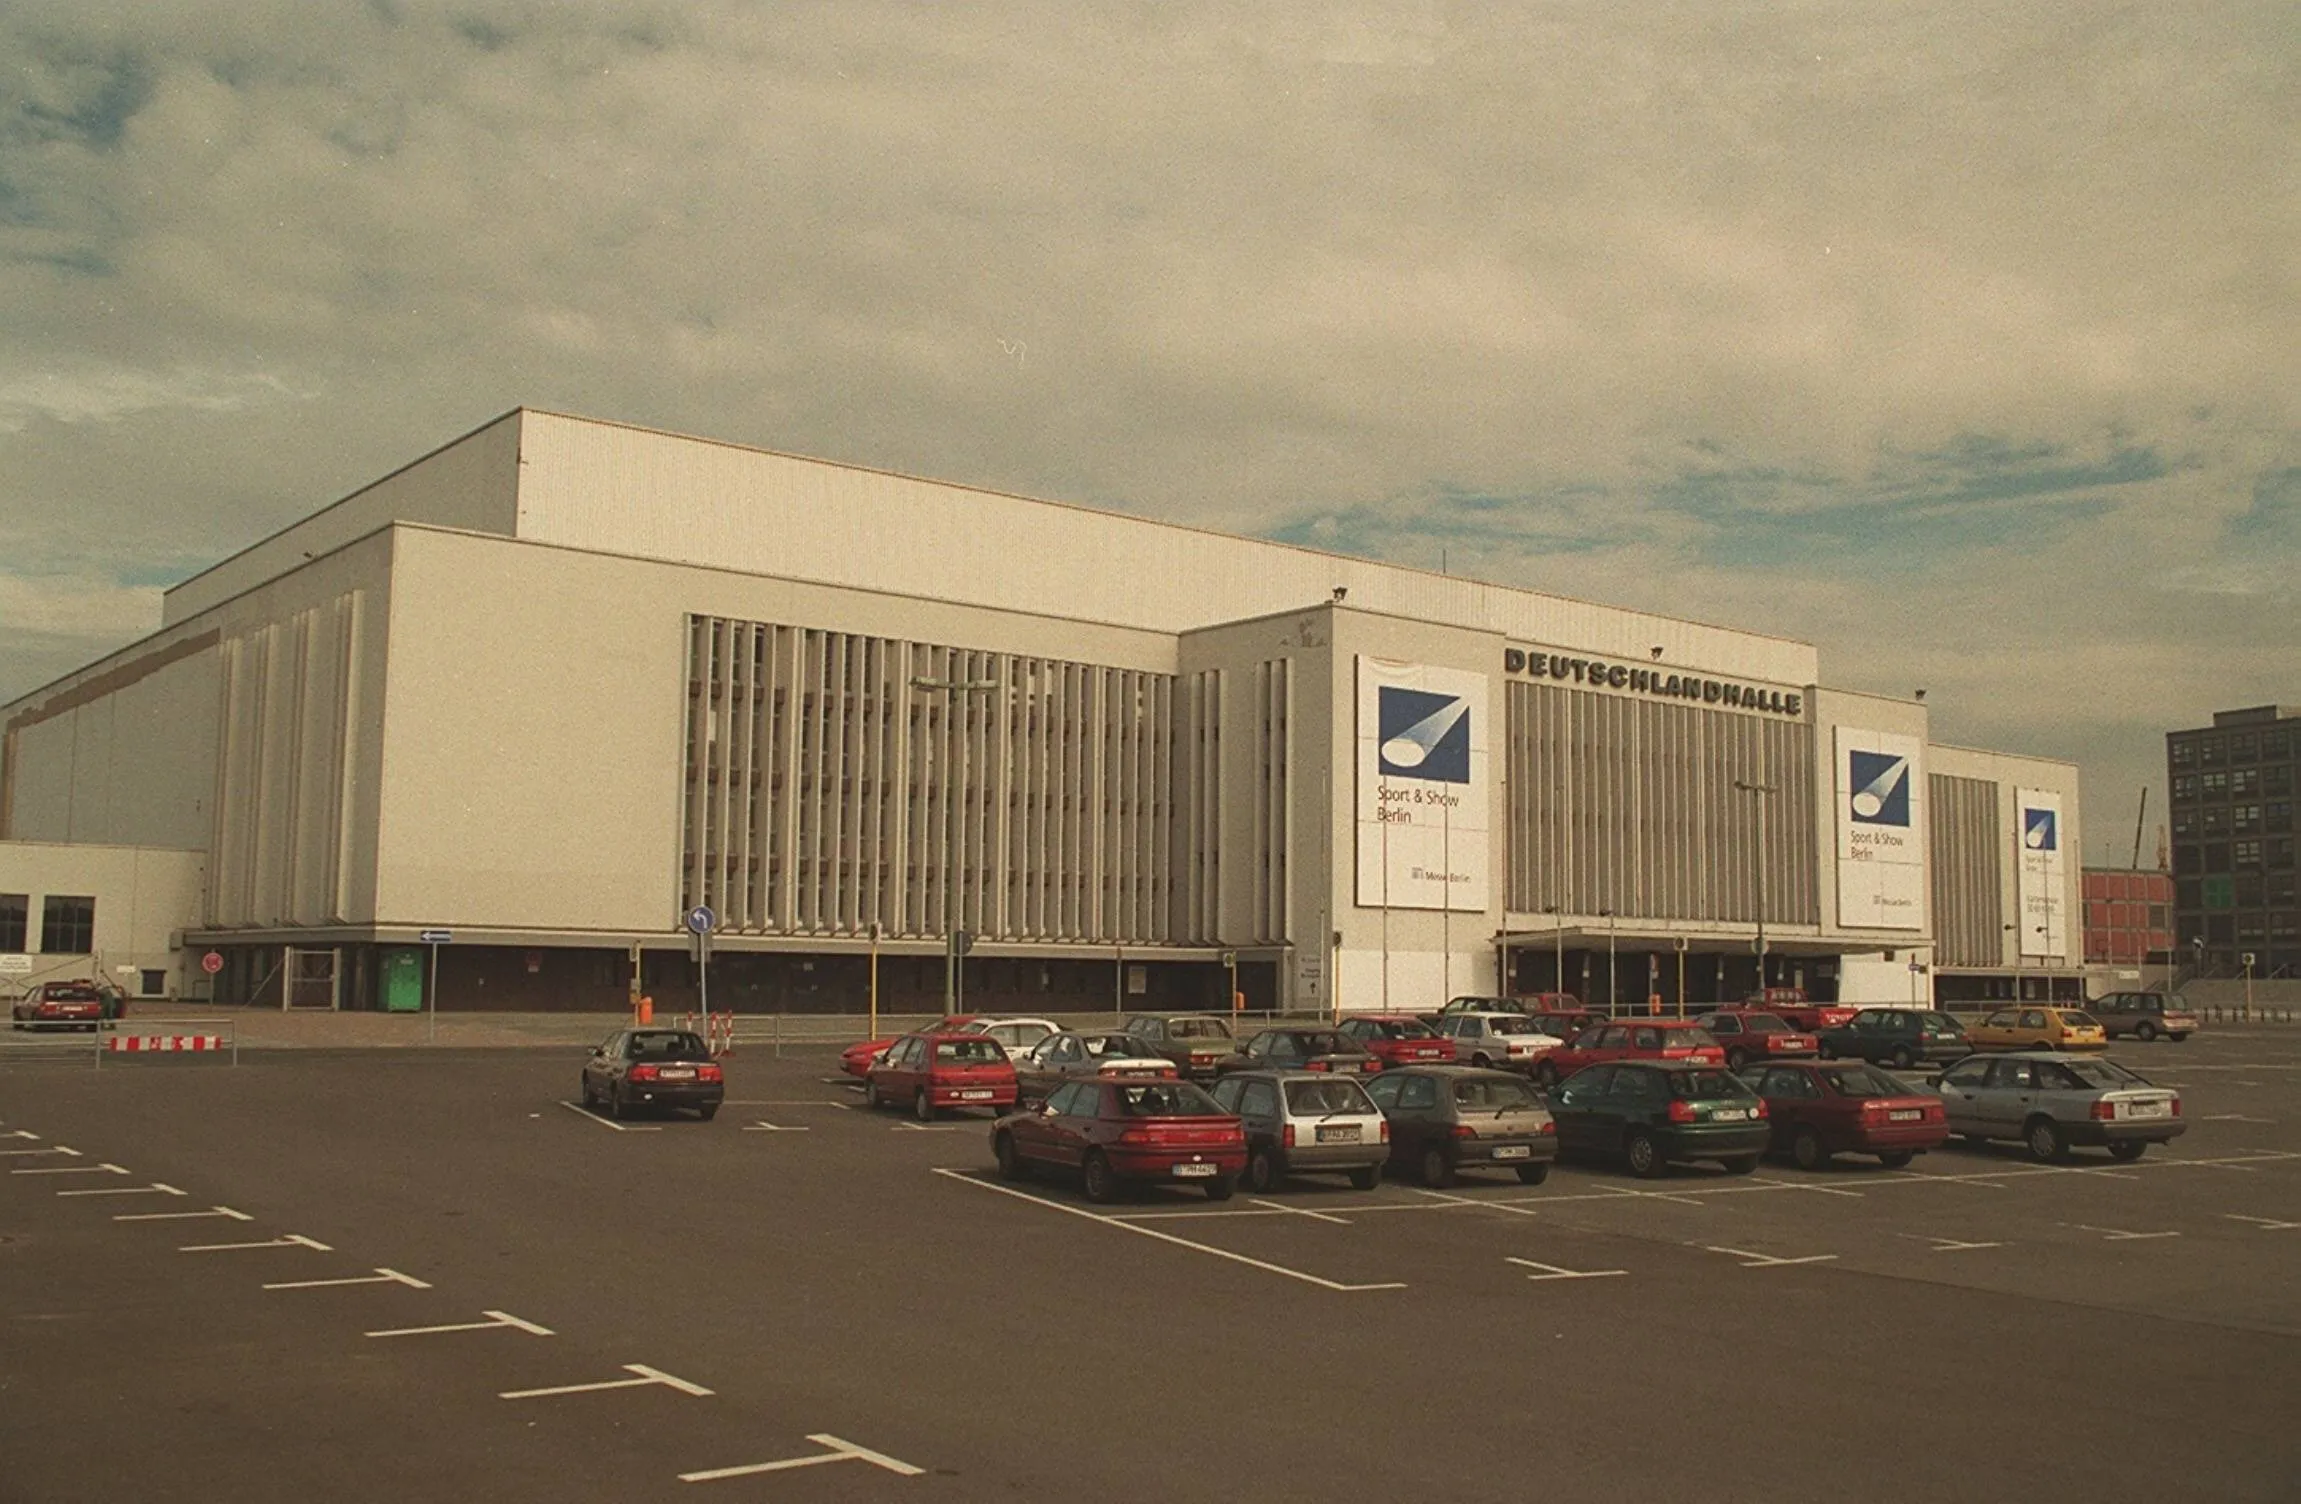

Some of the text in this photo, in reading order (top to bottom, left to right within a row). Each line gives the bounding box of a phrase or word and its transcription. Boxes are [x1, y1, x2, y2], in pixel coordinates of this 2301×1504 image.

[1504, 647, 1802, 715] DEUTSCHLANDHALLE
[1377, 785, 1459, 807] Sport & Show
[1377, 806, 1411, 823] Berlin
